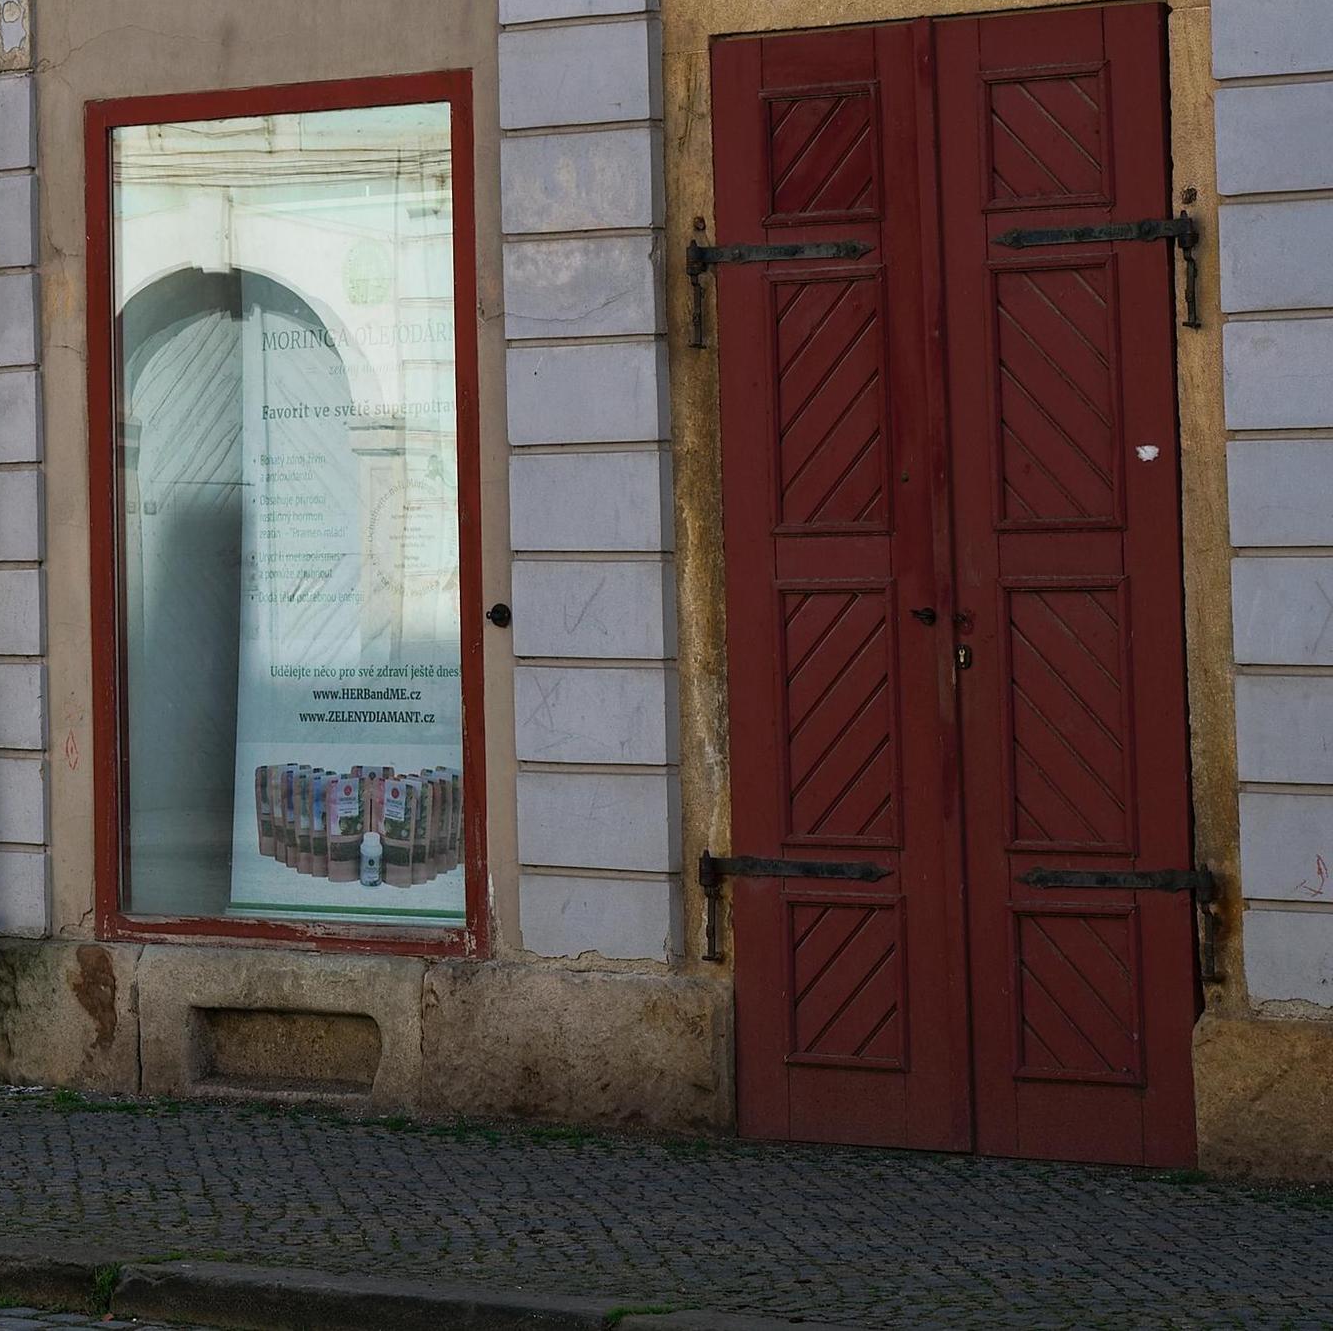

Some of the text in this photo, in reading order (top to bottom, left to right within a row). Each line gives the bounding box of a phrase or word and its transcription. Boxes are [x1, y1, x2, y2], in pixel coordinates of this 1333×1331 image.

[262, 328, 350, 352] MORINGA
[262, 402, 310, 421] Favorit
[313, 405, 331, 419] ve
[334, 399, 373, 418] světě
[270, 664, 311, 681] Udělejte
[313, 665, 336, 678] něco
[338, 668, 355, 680] pro
[357, 665, 374, 678] své
[377, 664, 409, 678] zdraví
[410, 665, 434, 681] ještě
[312, 687, 421, 702] www.HERBandME.cz
[299, 710, 435, 724] www.ZELENYDIAMANT.cz
